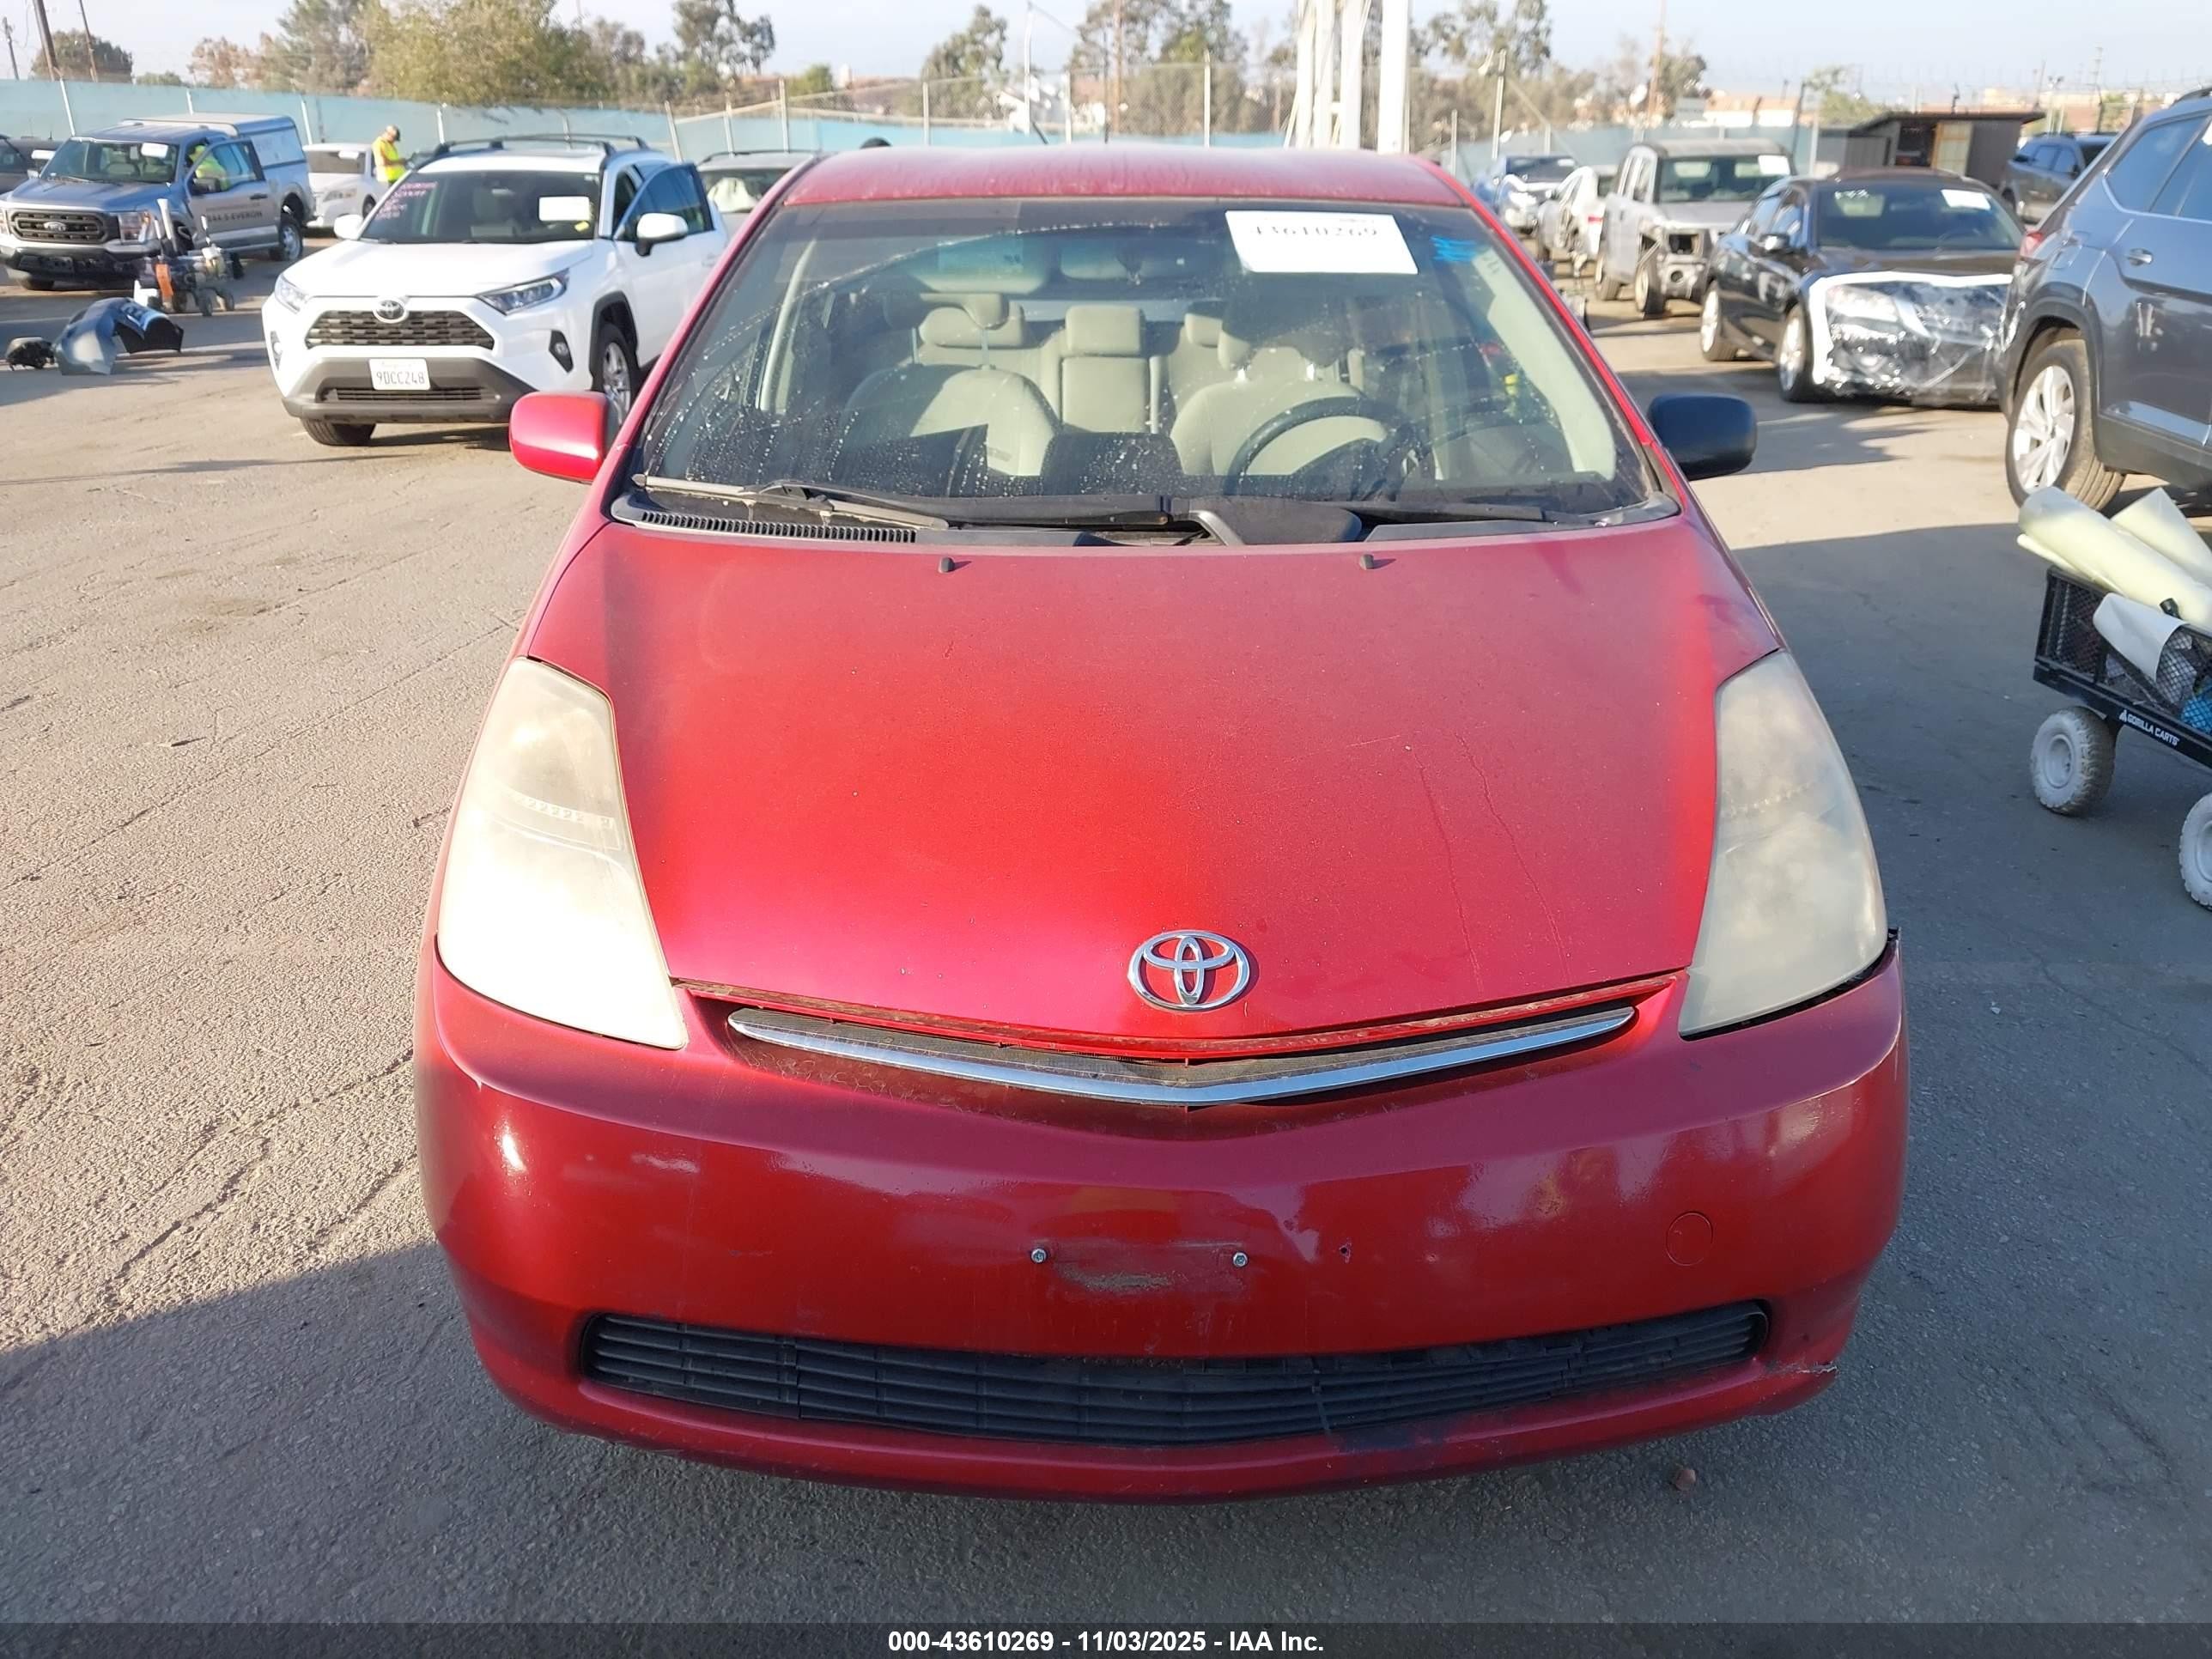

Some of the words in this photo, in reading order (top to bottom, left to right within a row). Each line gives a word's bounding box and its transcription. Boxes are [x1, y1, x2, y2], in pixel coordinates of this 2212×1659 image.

[376, 370, 426, 386] 9DCC248
[2127, 713, 2154, 735] GORILLA
[2154, 727, 2179, 746] CARTS
